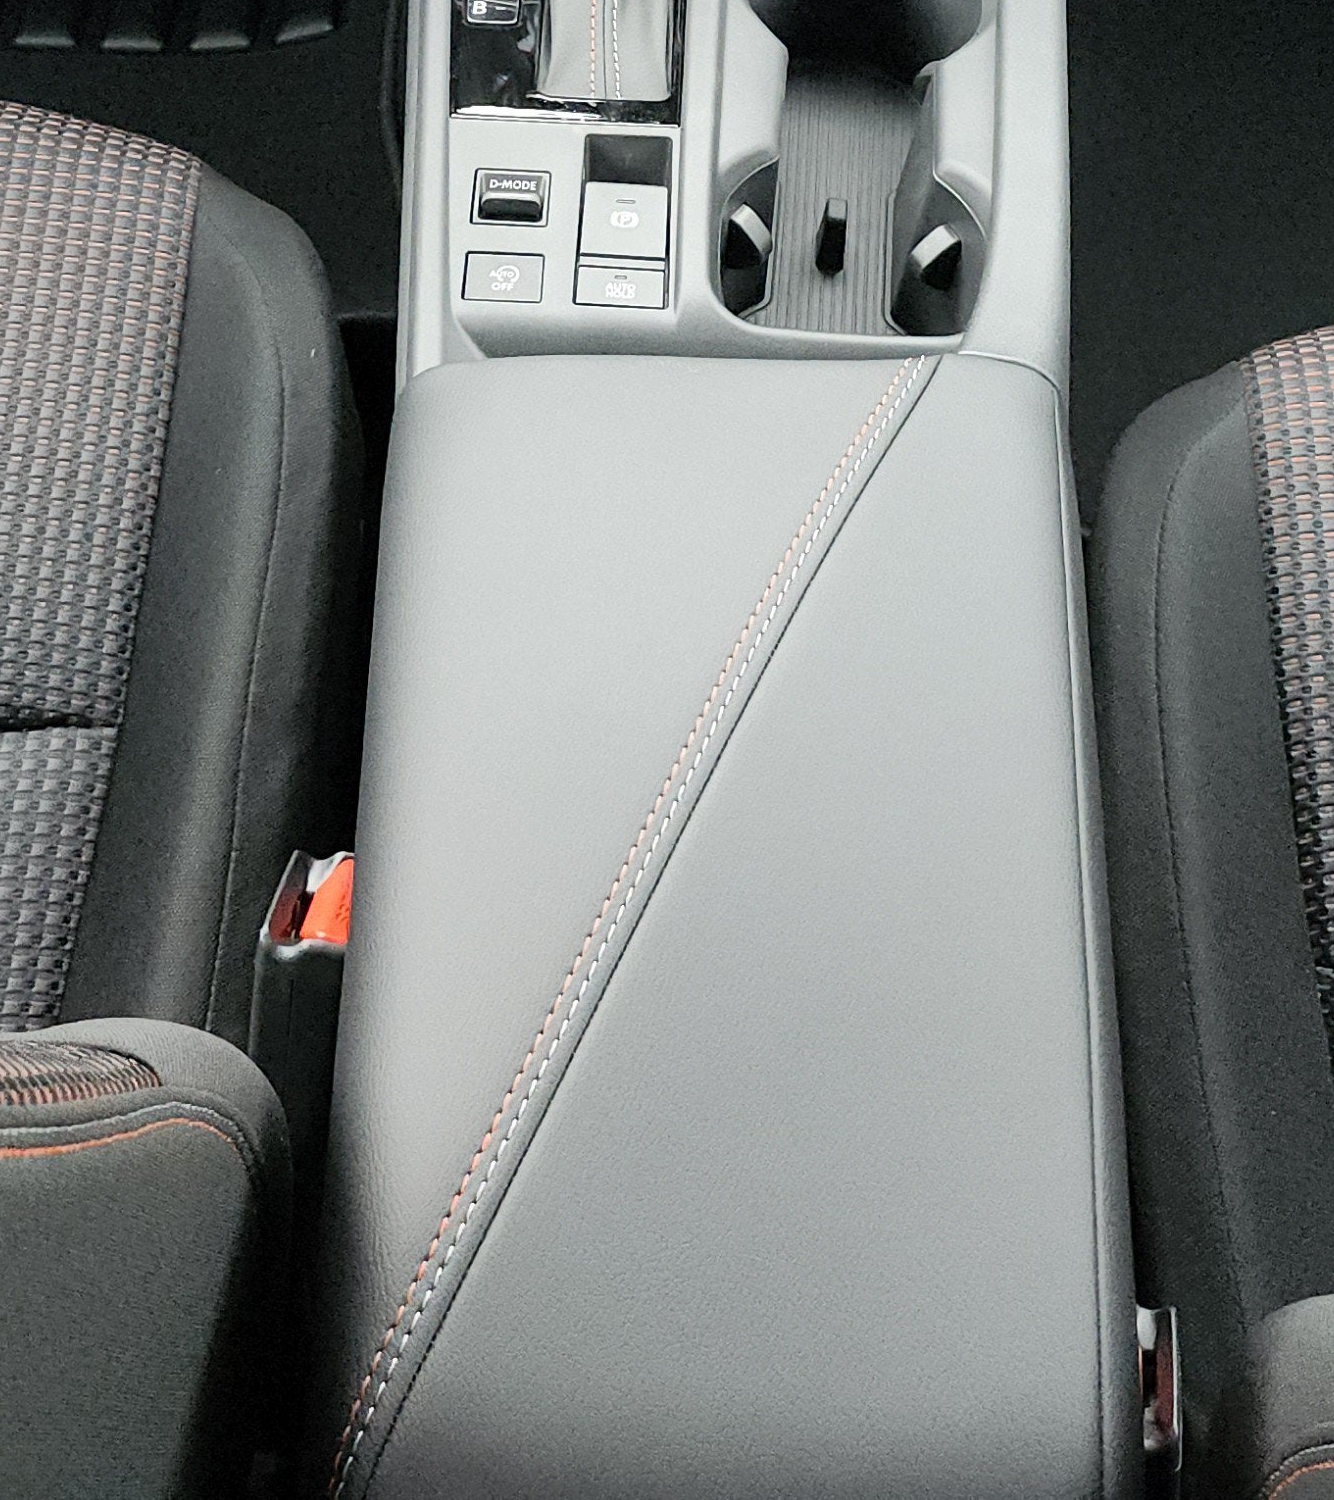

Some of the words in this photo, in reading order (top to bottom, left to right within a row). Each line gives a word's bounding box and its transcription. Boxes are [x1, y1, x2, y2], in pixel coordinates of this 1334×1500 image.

[472, 1, 487, 15] B
[489, 178, 537, 191] D-MODE
[489, 270, 515, 278] AUTO
[491, 282, 515, 291] OFF
[605, 282, 636, 292] AUTO
